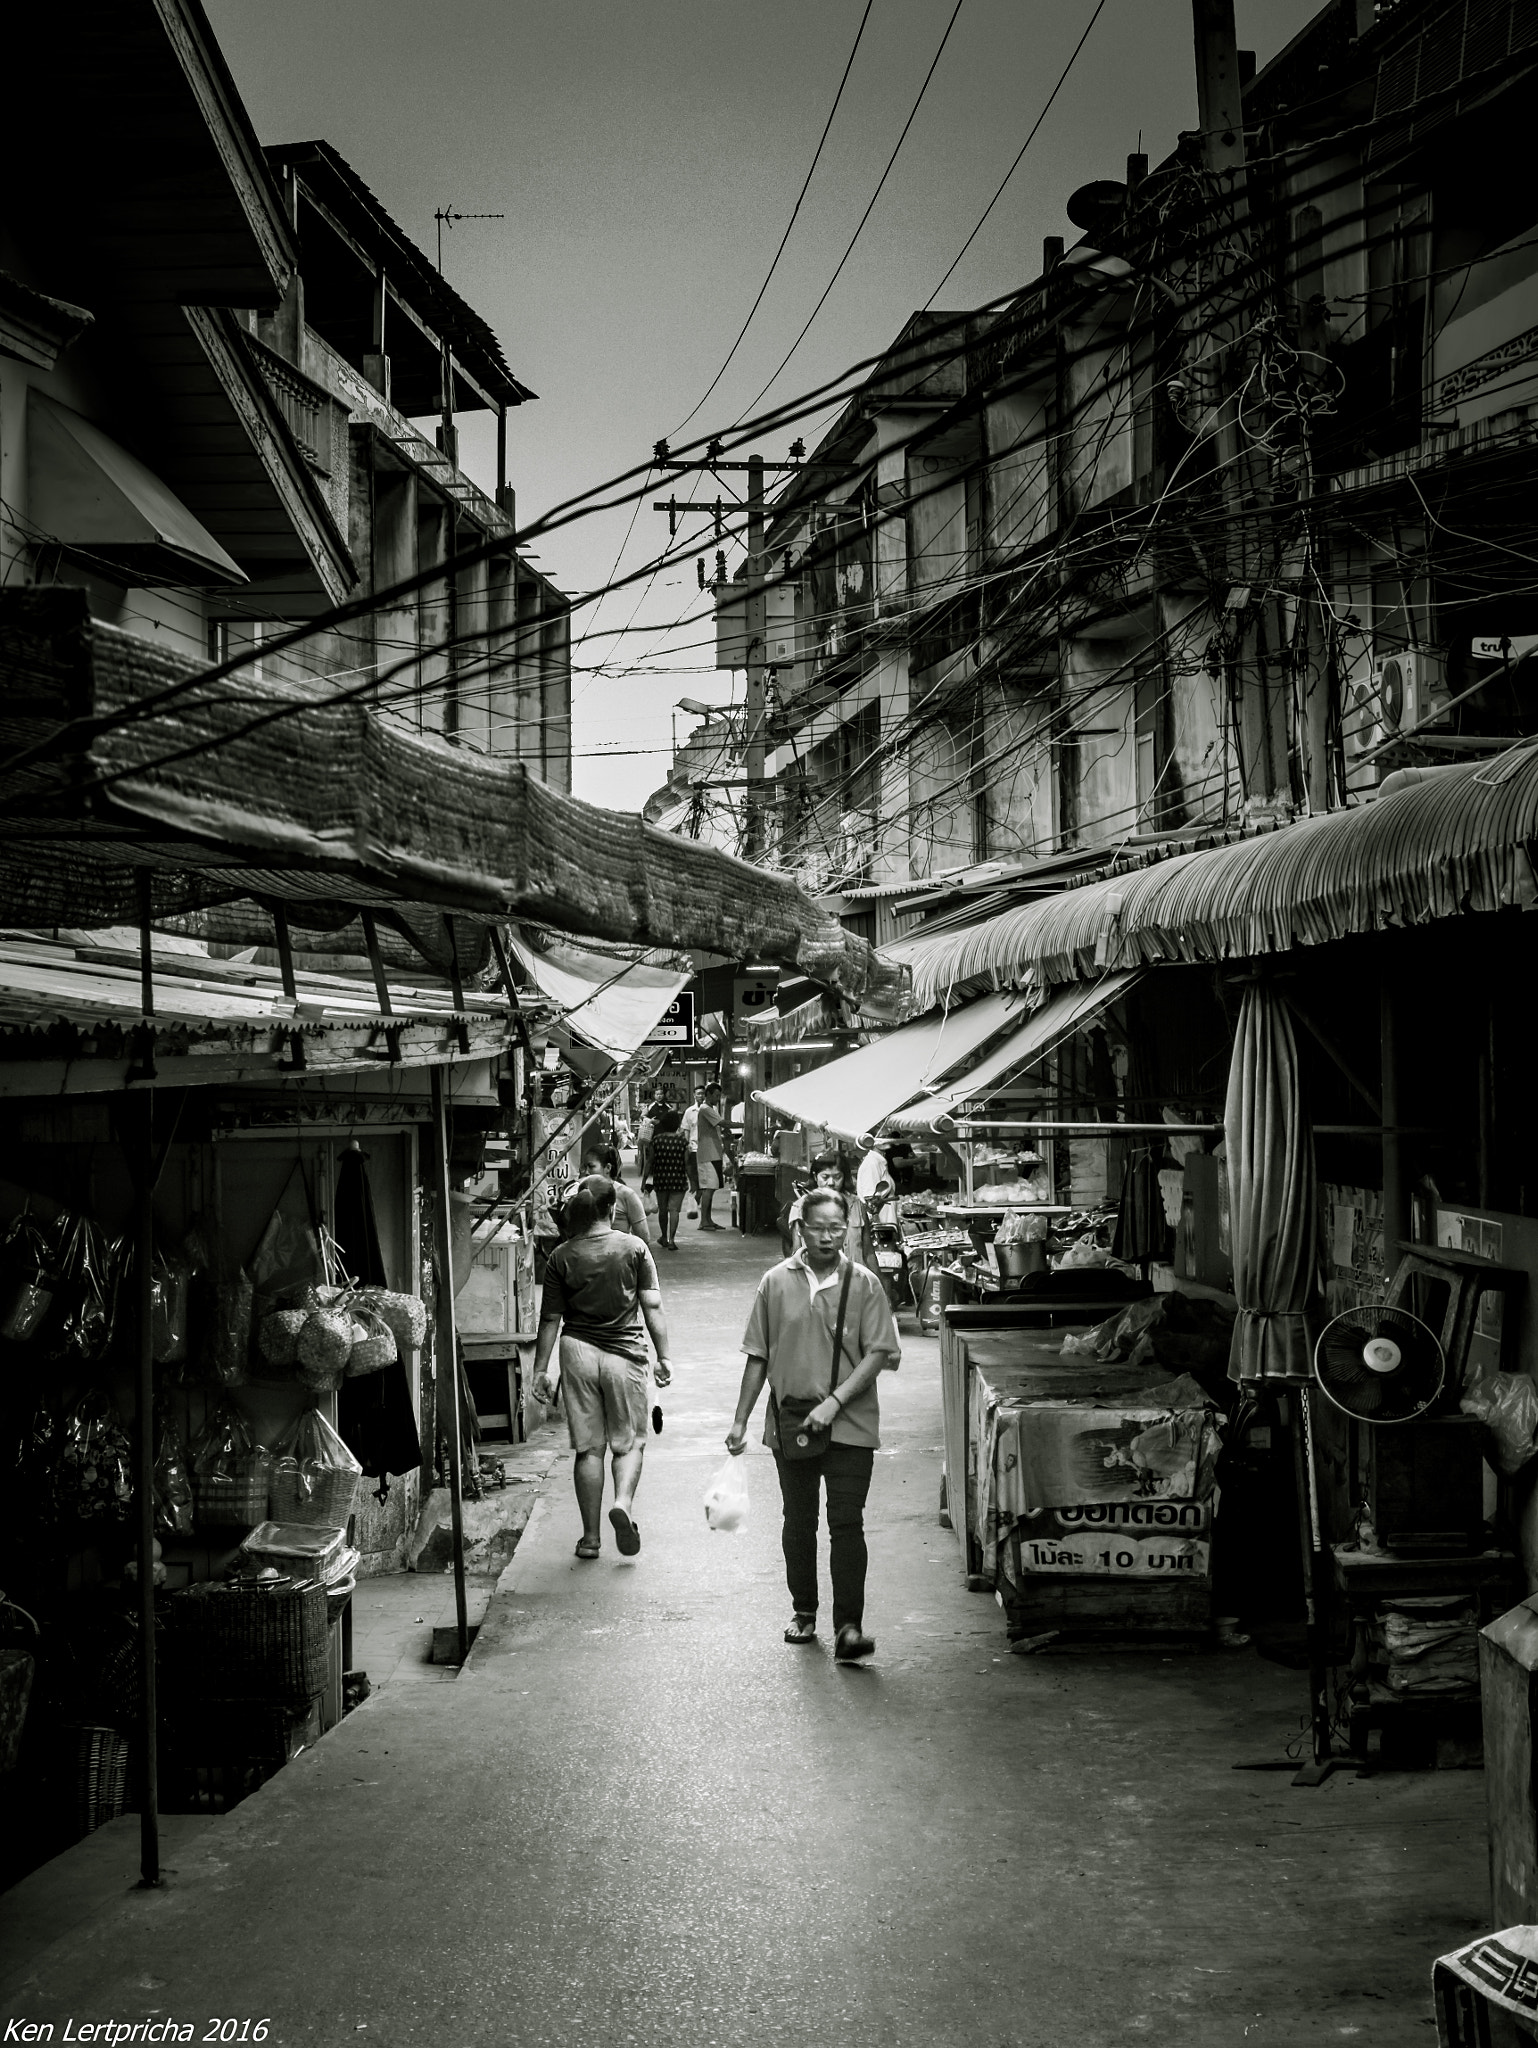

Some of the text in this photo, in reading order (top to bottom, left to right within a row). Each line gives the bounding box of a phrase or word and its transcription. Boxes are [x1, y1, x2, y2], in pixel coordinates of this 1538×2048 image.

[1481, 642, 1502, 652] tru
[1029, 1541, 1194, 1569] ไม้ละ 10 บาท
